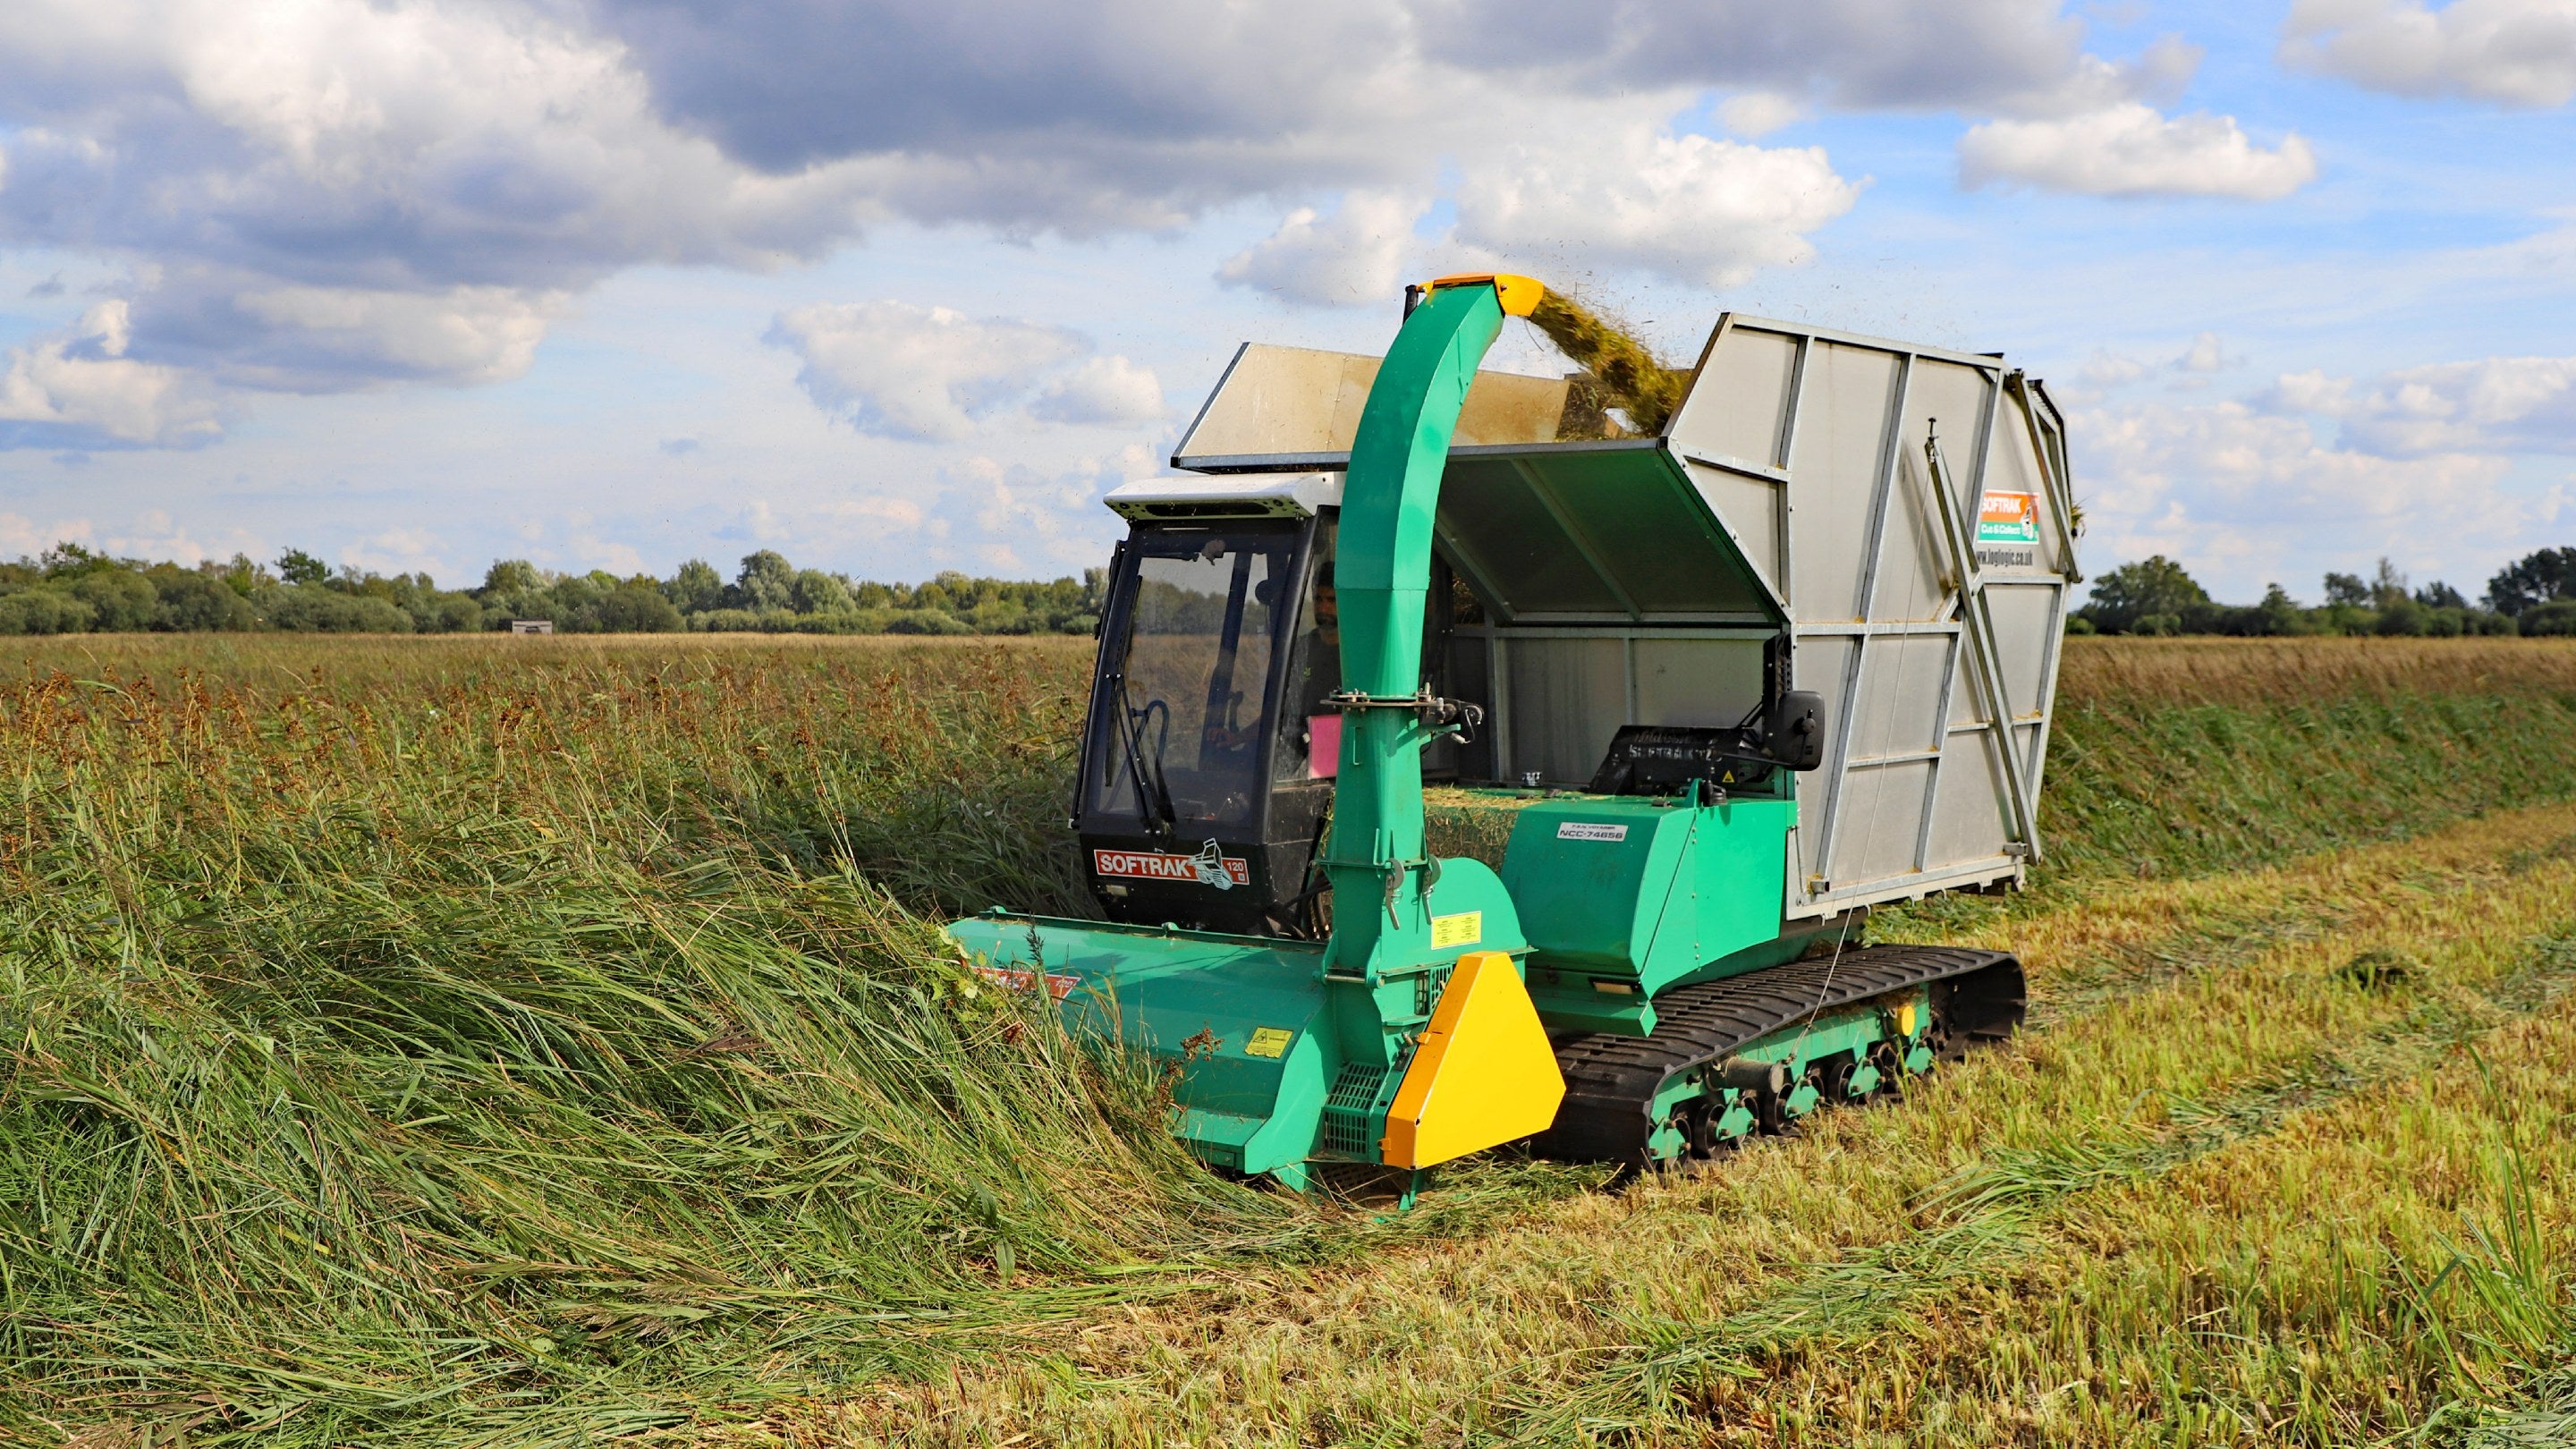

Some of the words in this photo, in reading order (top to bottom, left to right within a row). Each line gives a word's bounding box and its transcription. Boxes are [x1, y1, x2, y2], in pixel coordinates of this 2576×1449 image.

[1980, 524, 1993, 534] Cut
[2000, 524, 2021, 535] Collect
[1100, 854, 1191, 877] SOFTRAK
[1227, 861, 1244, 871] 120
